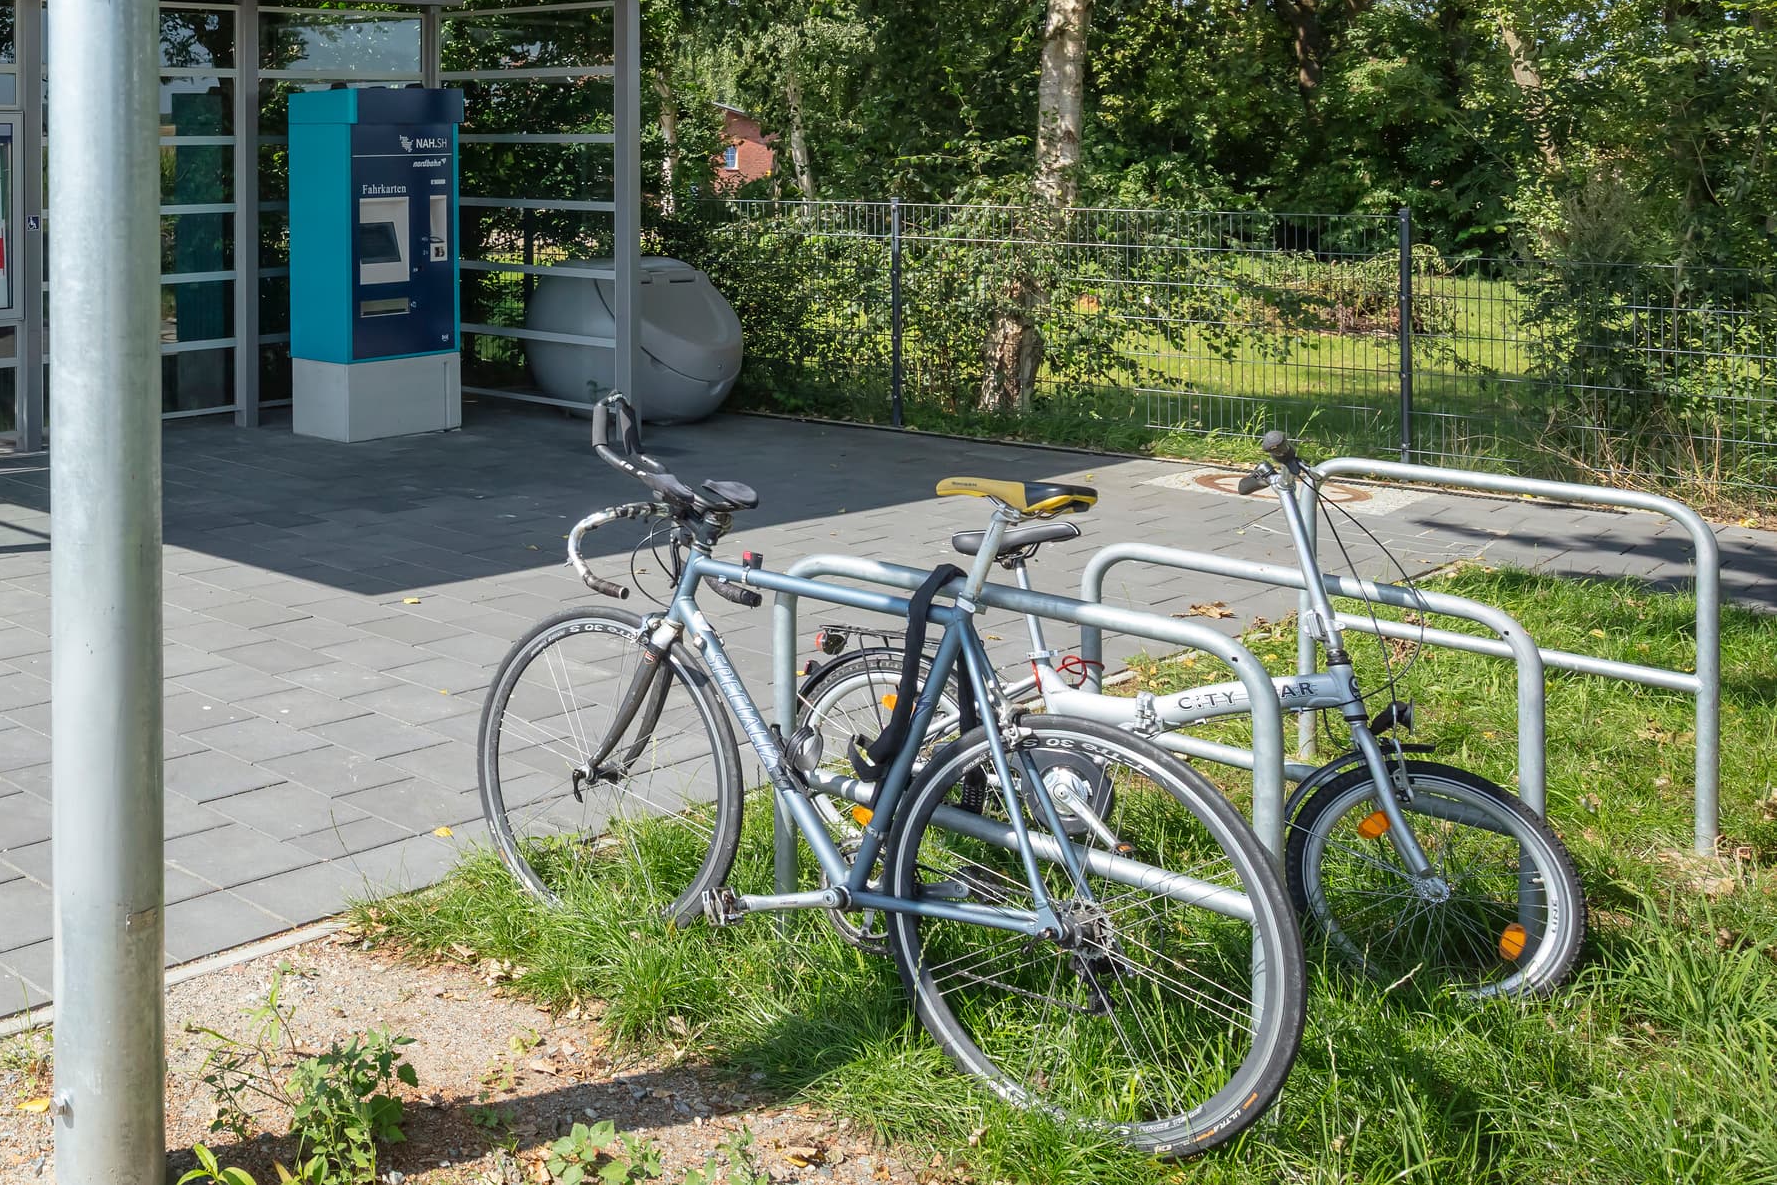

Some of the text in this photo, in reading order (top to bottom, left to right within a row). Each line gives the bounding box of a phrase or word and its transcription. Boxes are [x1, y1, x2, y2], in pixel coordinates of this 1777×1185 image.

[416, 138, 447, 149] NAH.SH
[362, 184, 407, 195] Fahrkarten
[708, 654, 780, 773] SPECIALIZ
